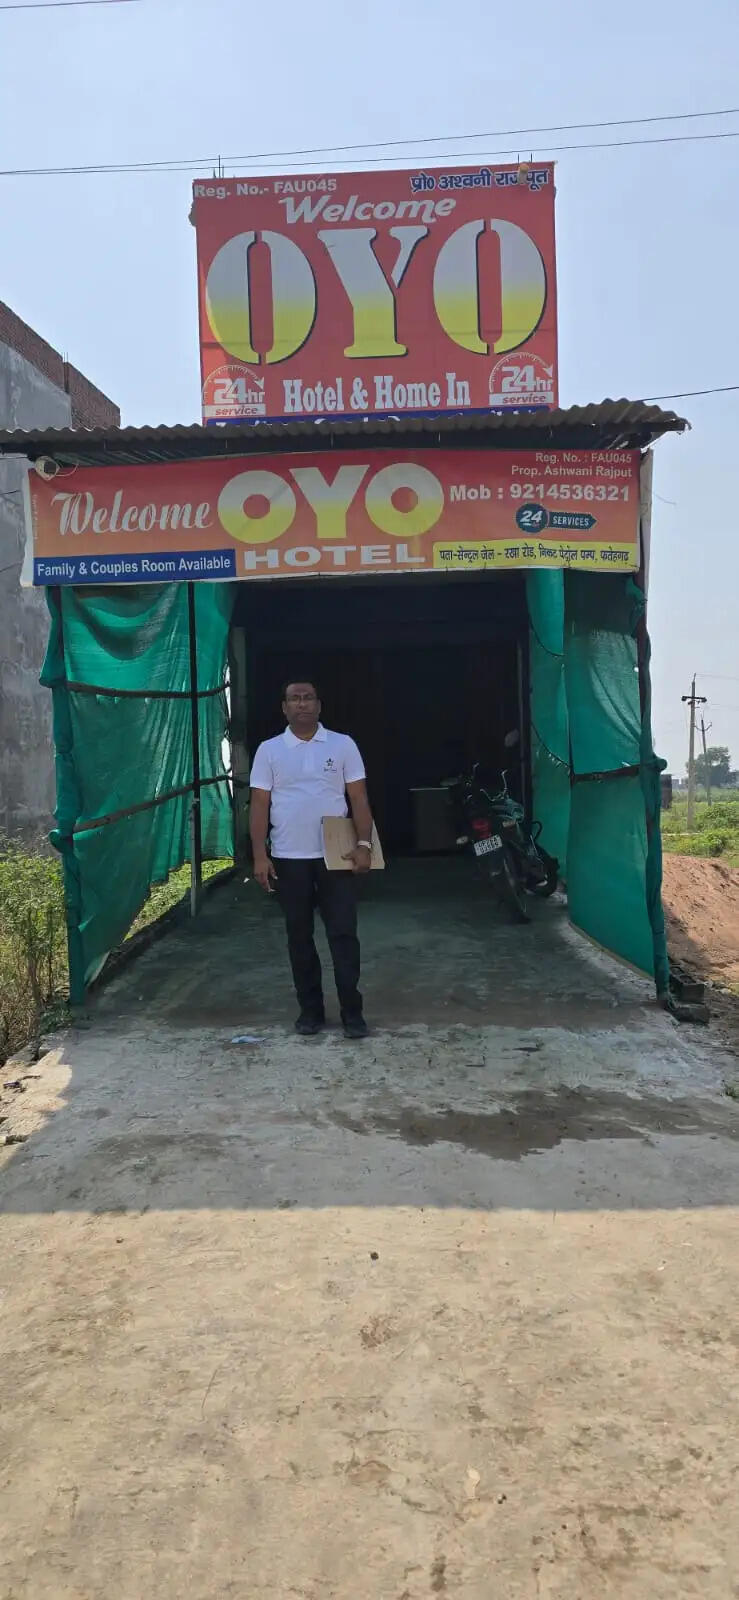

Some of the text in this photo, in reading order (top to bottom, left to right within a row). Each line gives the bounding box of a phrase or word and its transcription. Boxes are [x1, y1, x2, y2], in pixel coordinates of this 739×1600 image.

[194, 184, 231, 199] Reg.
[274, 178, 337, 194] FAU045
[438, 167, 491, 190] अश्वनी
[279, 194, 457, 224] Welcome
[205, 218, 547, 365] OYO
[213, 377, 266, 404] 24hr
[501, 365, 553, 393] 24hr
[283, 372, 471, 413] Hotel & Home In
[502, 394, 547, 404] service
[215, 405, 259, 416] service
[535, 453, 559, 464] Reg.
[563, 453, 581, 463] No.
[592, 453, 632, 463] FAU045
[511, 465, 632, 479] Prop. Ashwani Rajput
[217, 462, 445, 544] OYO
[450, 484, 491, 501] Mob
[510, 484, 629, 501] 9214536321
[50, 488, 213, 536] Welcome
[520, 510, 590, 526] 24 SERVICES
[244, 543, 425, 570] HOTEL
[480, 545, 495, 560] जेल
[521, 543, 537, 559] रोड,
[538, 543, 557, 558] निकट
[559, 545, 578, 563] पेट्रोल
[37, 555, 231, 578] Family & Couples Room Available
